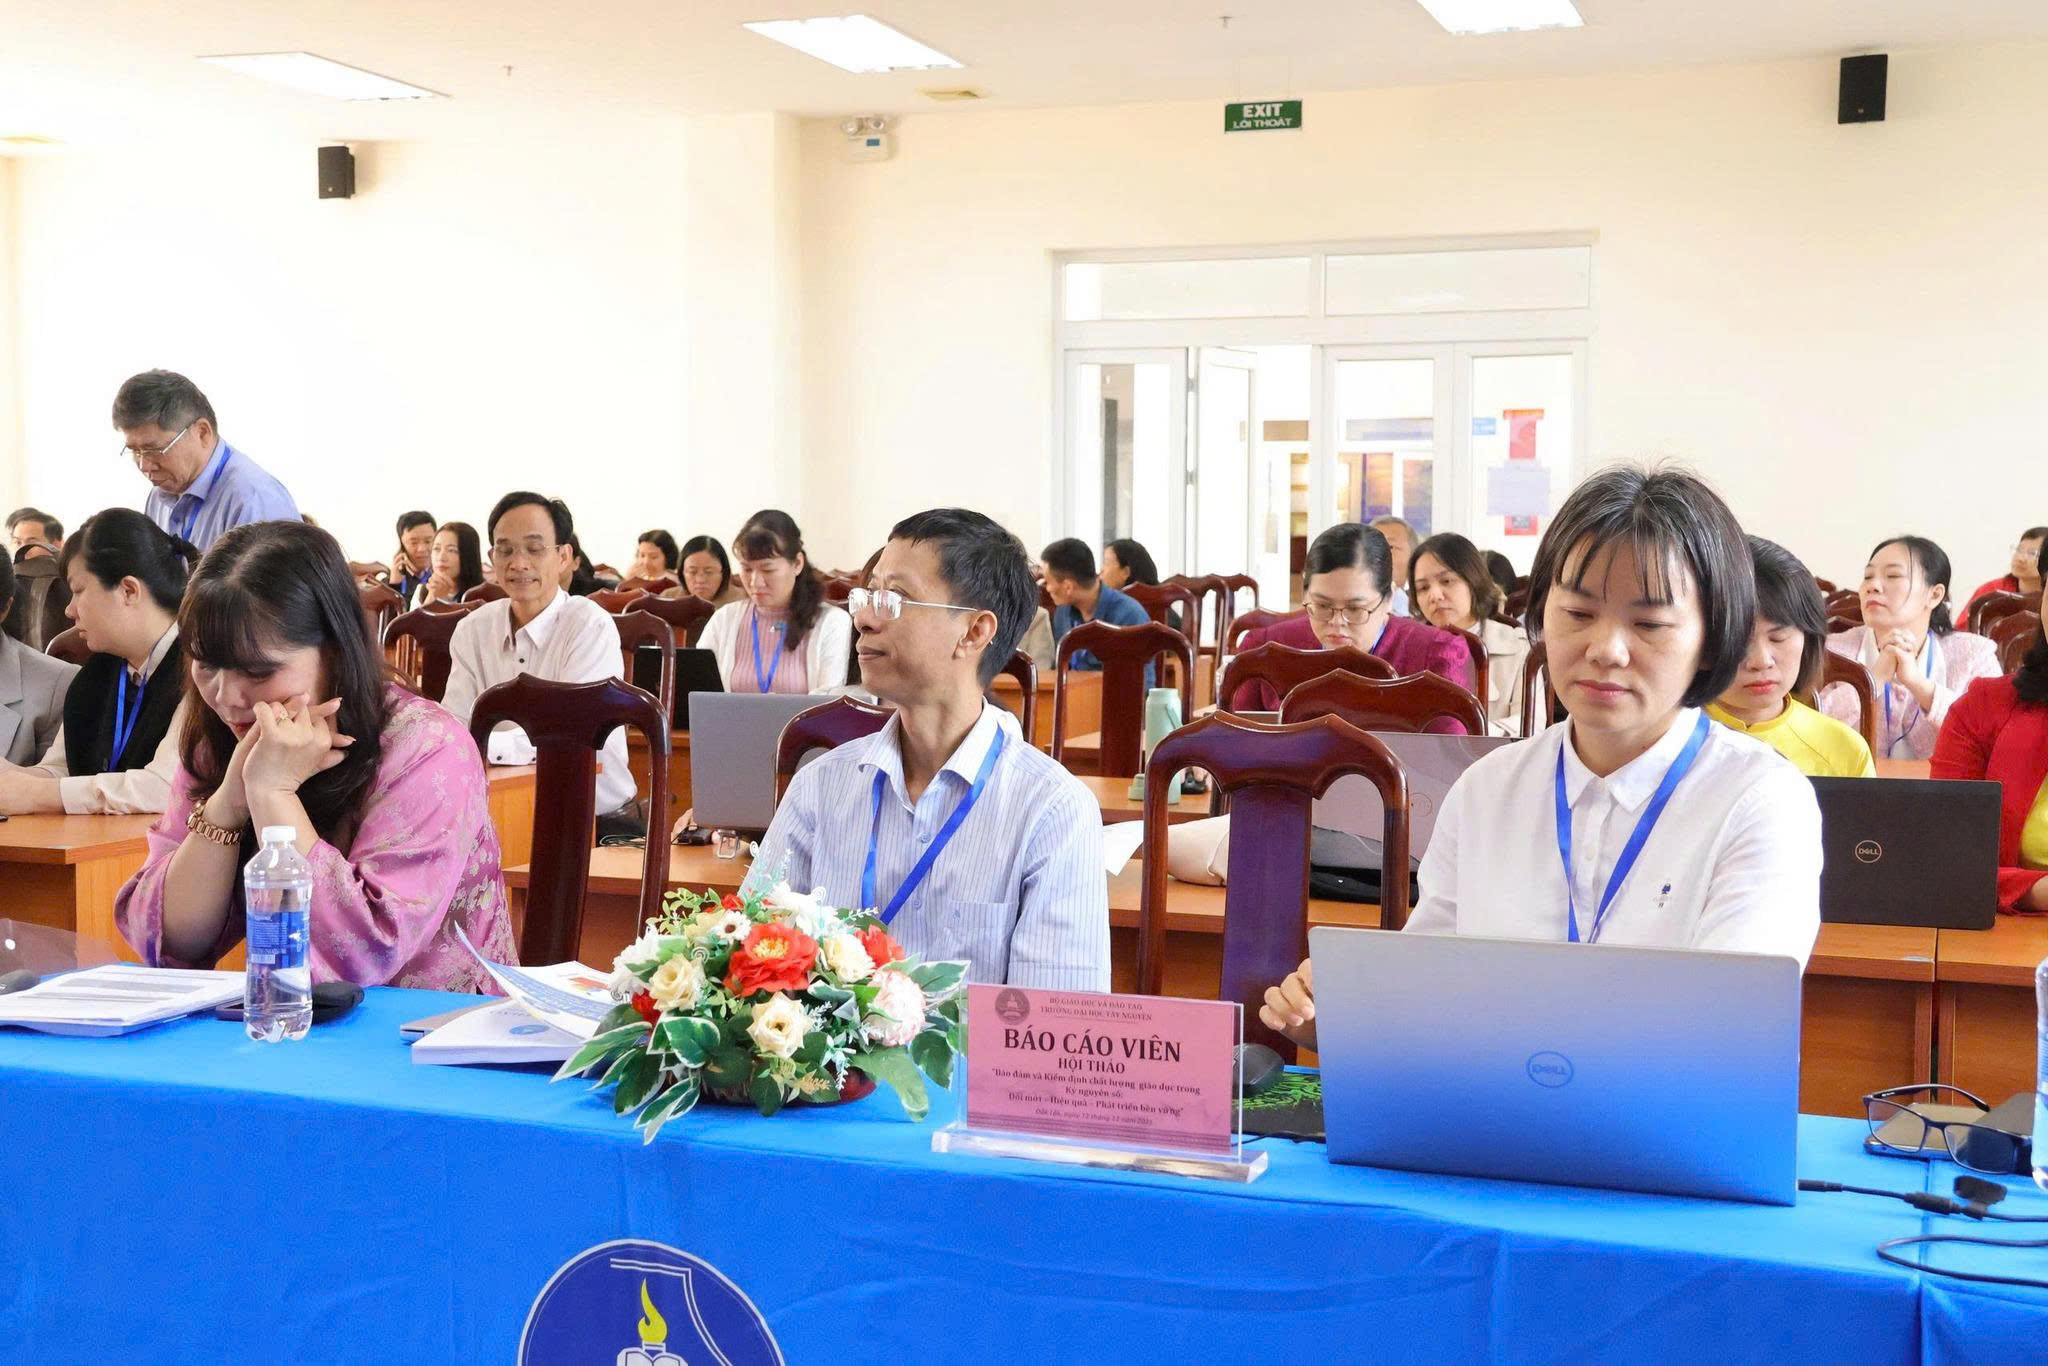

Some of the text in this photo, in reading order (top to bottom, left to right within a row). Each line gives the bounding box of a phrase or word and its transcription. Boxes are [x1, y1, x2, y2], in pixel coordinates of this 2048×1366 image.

[1243, 103, 1283, 118] EXIT
[1004, 1025, 1181, 1063] BÁO CÁO VIÊN
[1058, 1057, 1126, 1075] HỘI THẢO
[1176, 1084, 1200, 1096] trong
